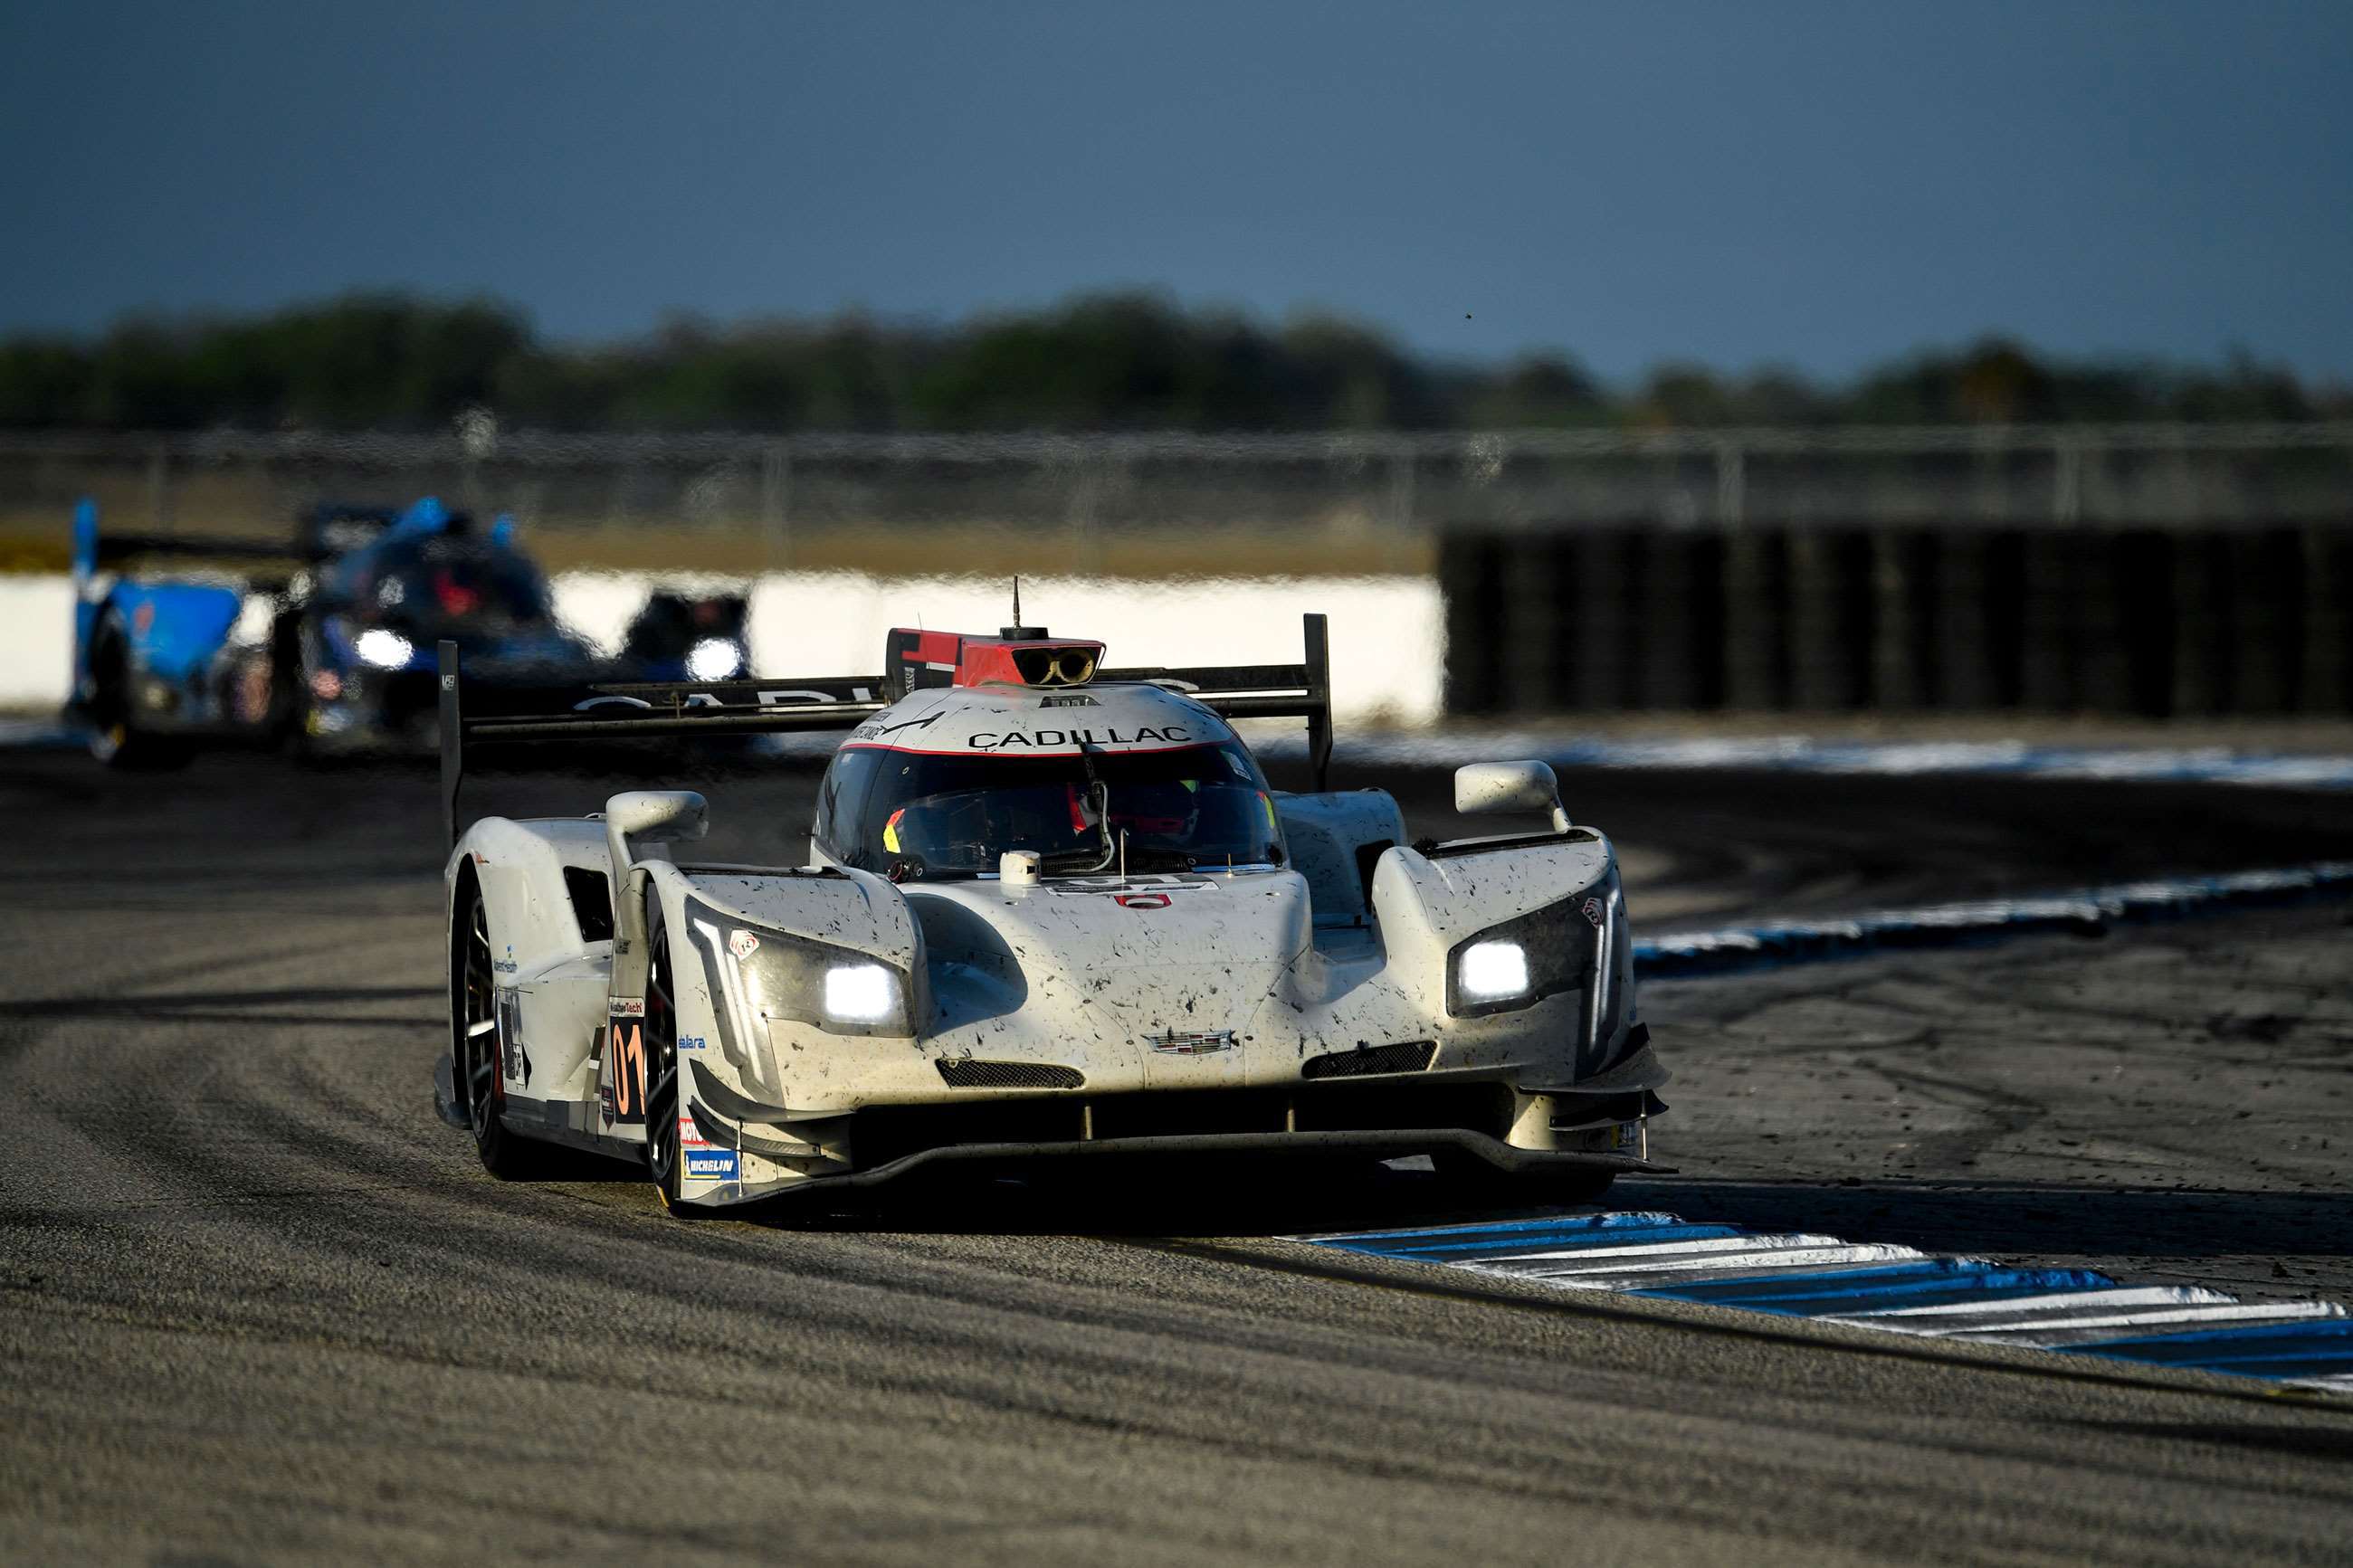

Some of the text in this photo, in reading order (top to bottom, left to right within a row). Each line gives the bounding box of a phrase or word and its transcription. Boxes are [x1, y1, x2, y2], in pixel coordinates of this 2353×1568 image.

[968, 727, 1191, 748] CADILLAC
[613, 1024, 645, 1115] 01
[690, 1160, 733, 1173] MICHELIN
